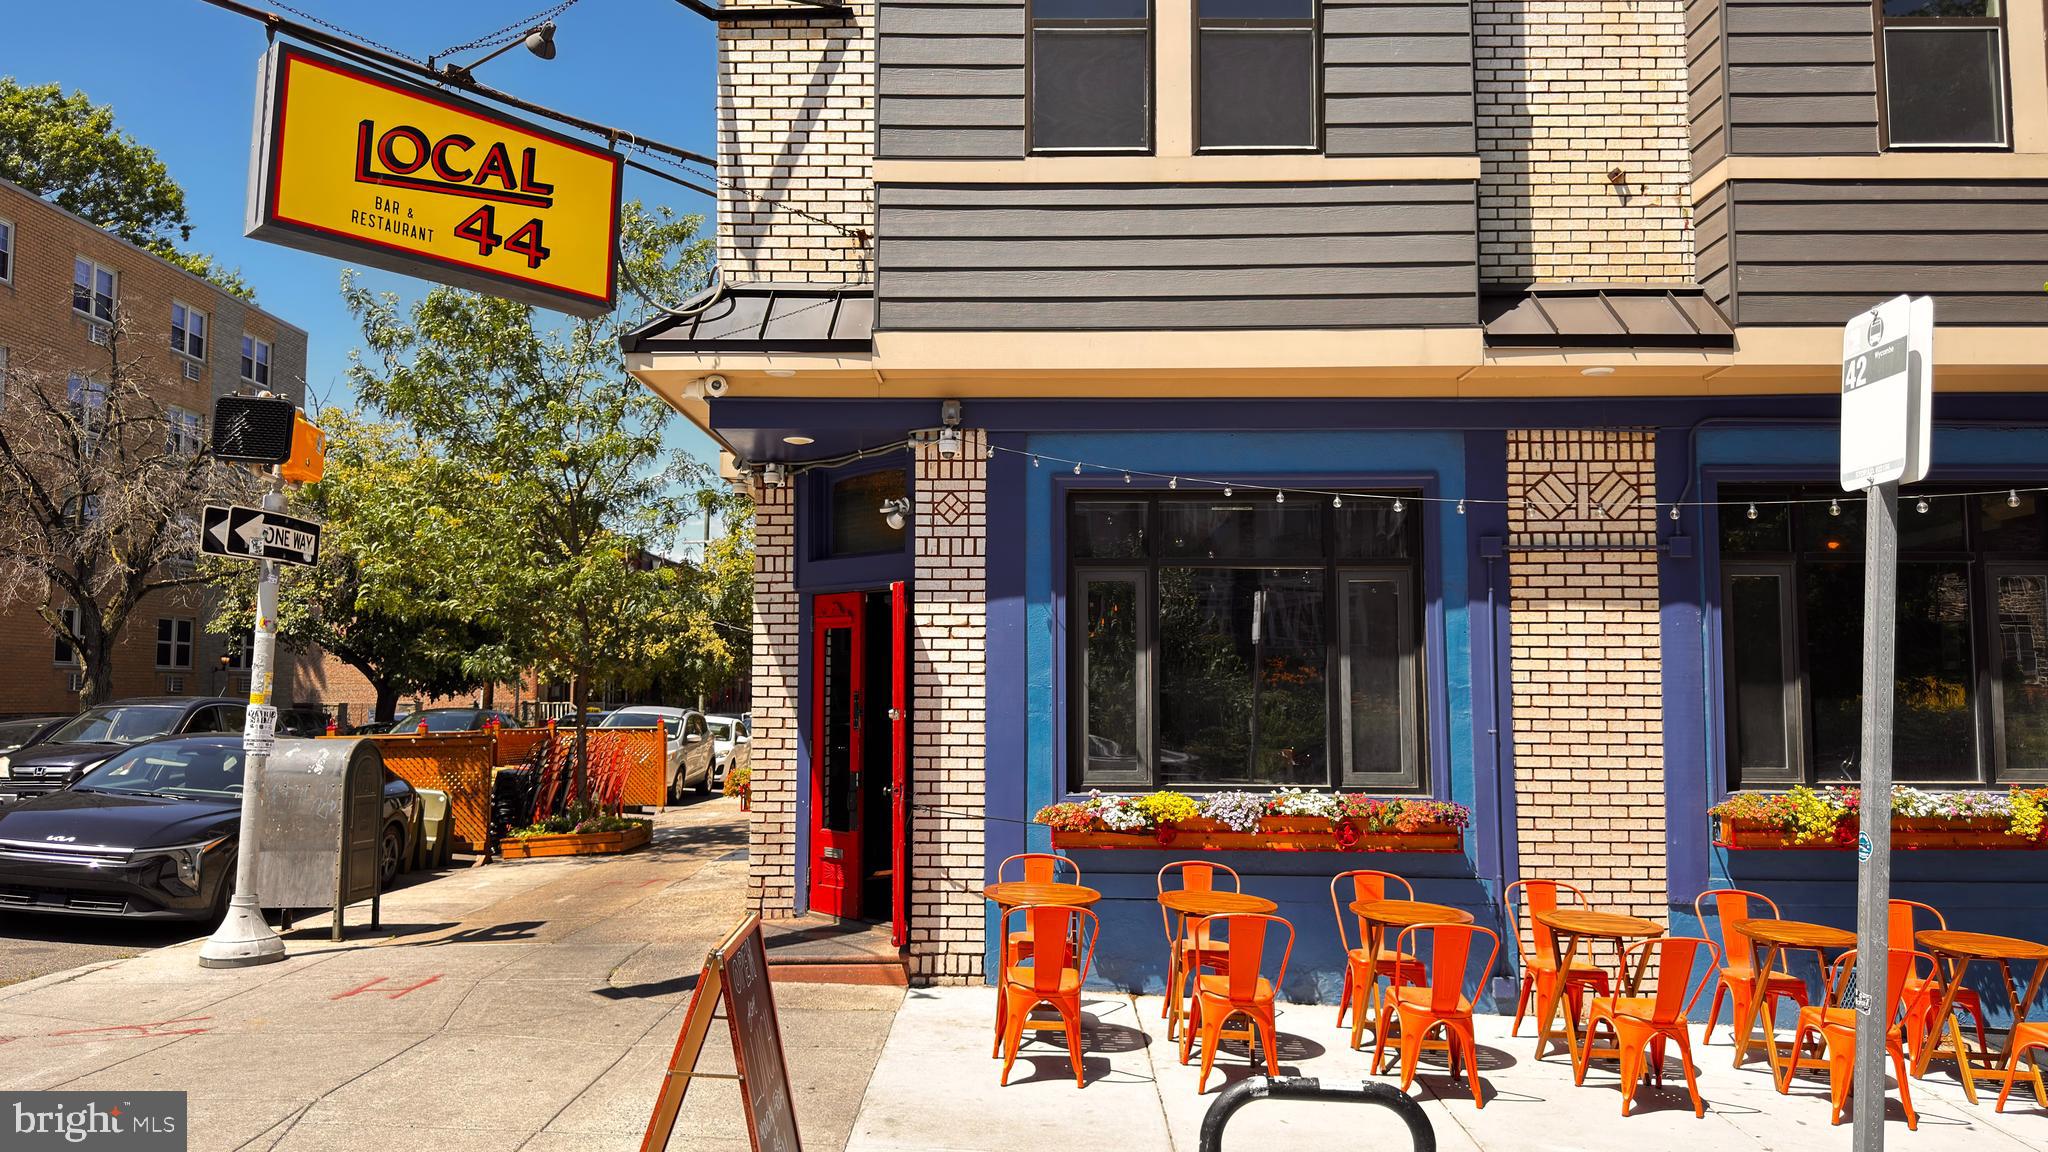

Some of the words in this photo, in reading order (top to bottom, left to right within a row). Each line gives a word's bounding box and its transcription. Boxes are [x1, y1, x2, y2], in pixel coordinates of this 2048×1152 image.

[354, 119, 554, 202] LOCAL
[375, 196, 400, 215] BAR
[407, 207, 414, 219] &
[351, 209, 434, 243] RESTAURANT
[454, 204, 551, 269] 44
[1845, 355, 1867, 390] 42
[263, 526, 290, 547] ONE
[293, 531, 313, 551] WAY
